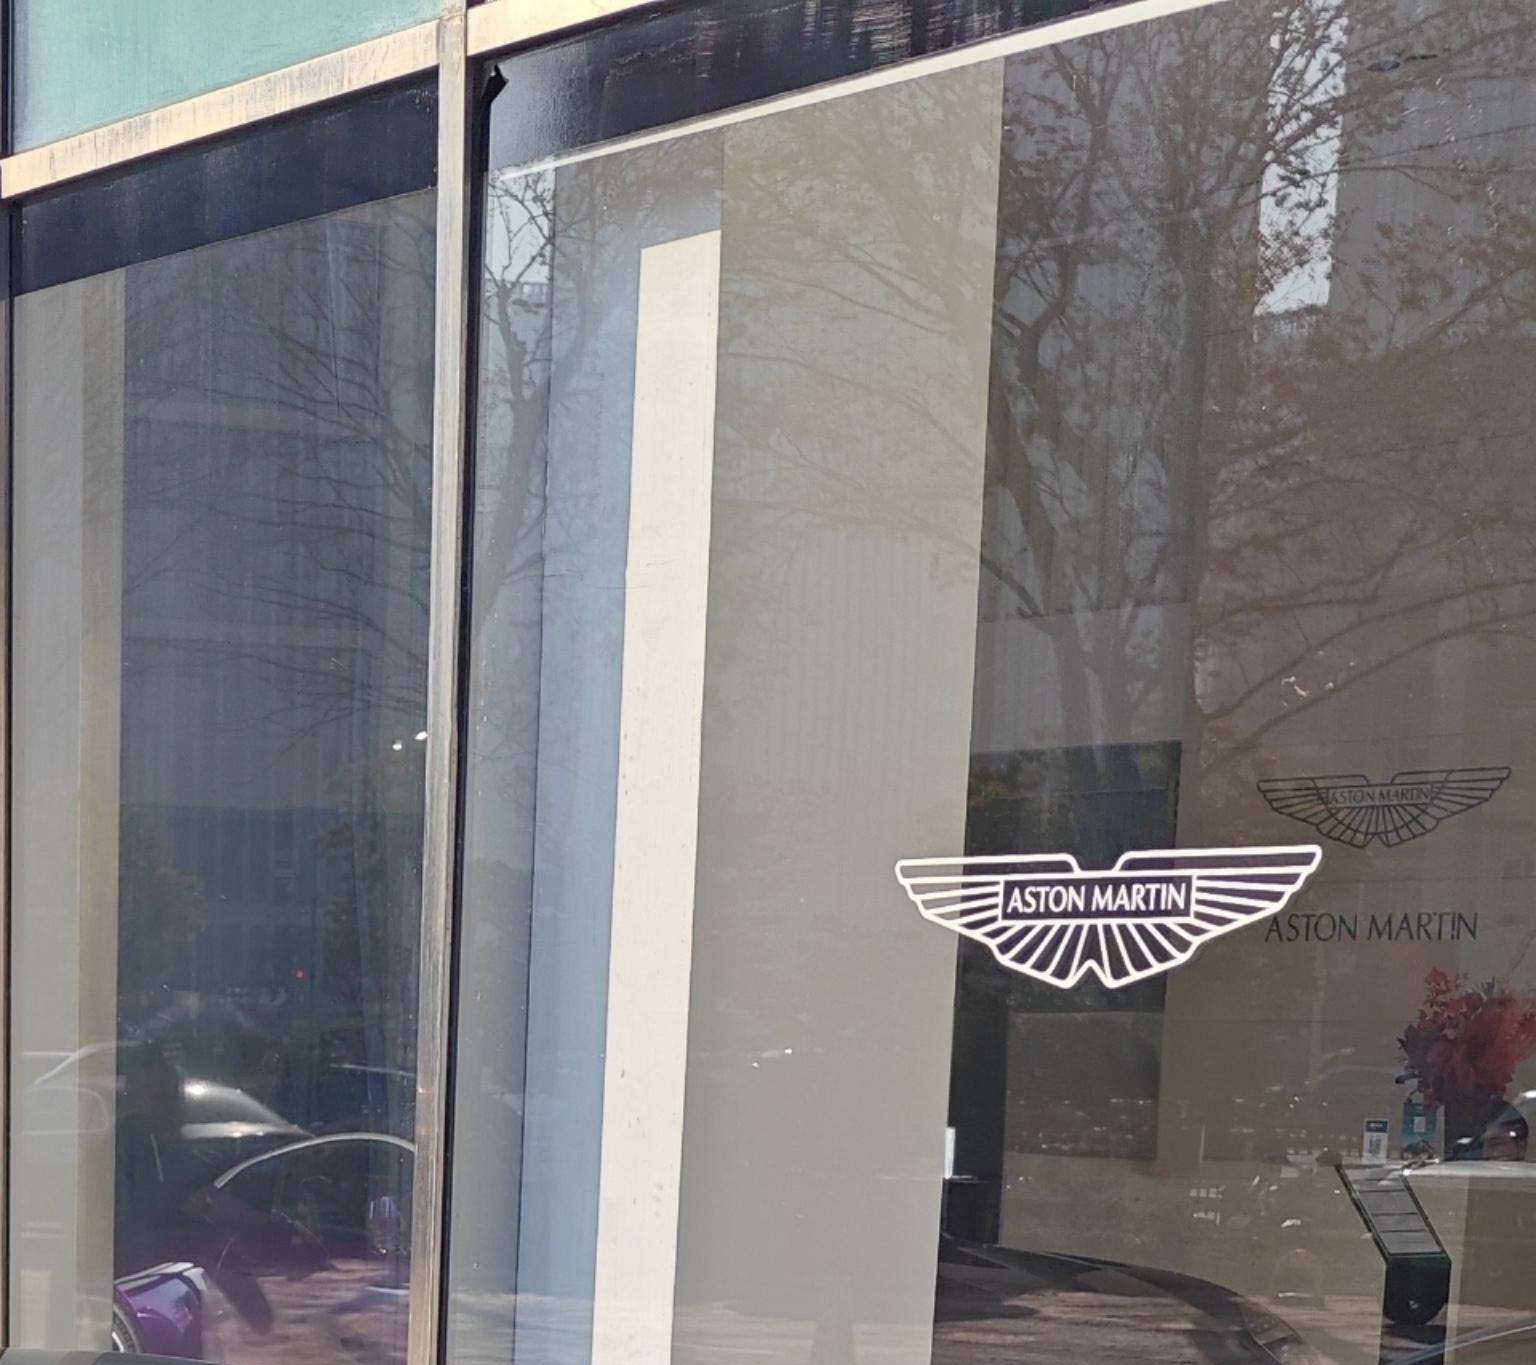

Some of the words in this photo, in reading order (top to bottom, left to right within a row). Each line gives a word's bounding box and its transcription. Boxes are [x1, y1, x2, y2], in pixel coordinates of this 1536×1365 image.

[1328, 785, 1378, 805] ASTON
[1380, 783, 1432, 802] MARTIN
[1006, 885, 1085, 913] ASTON
[1091, 883, 1185, 911] MARTIN
[1265, 913, 1358, 942] ASTON
[1367, 912, 1478, 940] MARTIN
